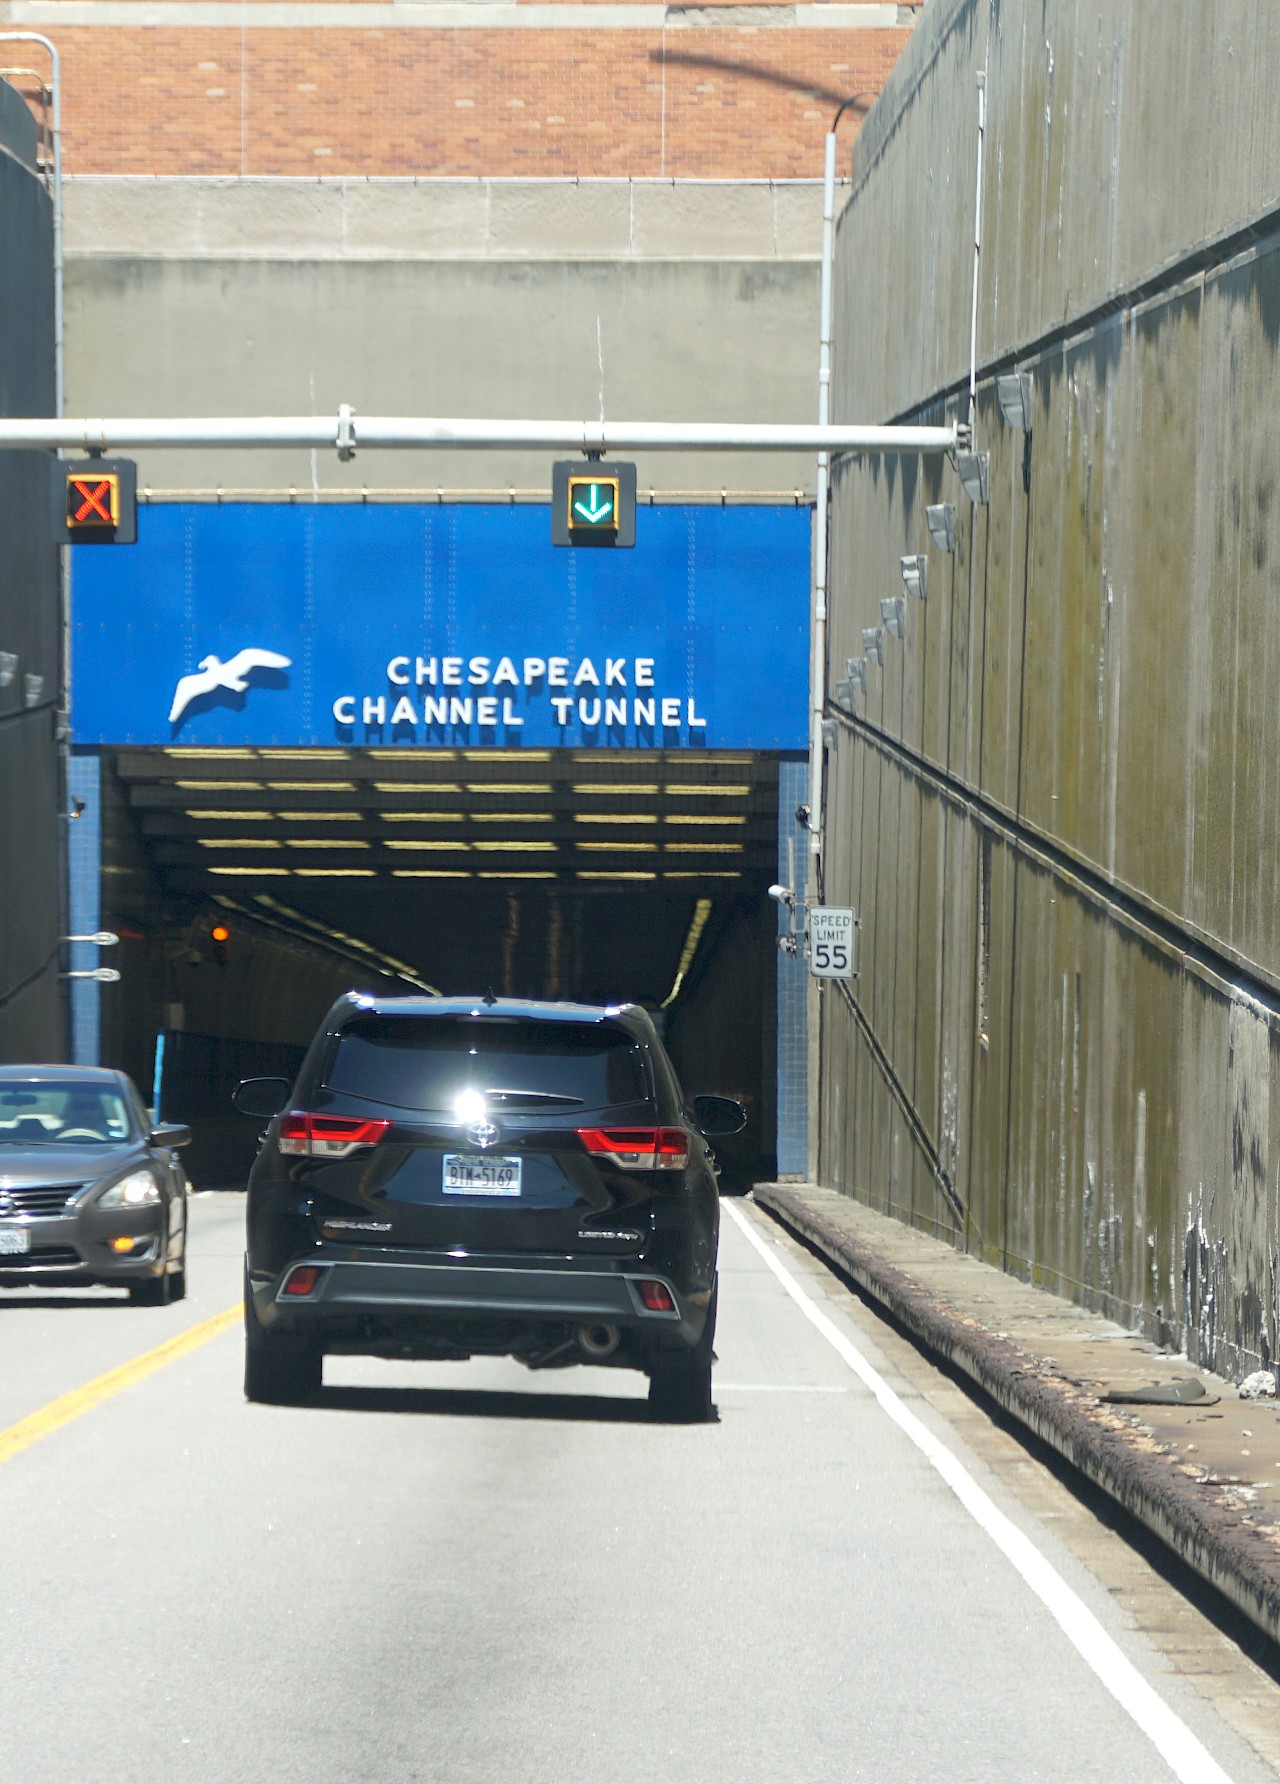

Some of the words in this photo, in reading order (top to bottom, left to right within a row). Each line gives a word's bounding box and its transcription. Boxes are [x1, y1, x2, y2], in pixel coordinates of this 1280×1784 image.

[386, 656, 655, 687] CHESAPEAKE
[332, 695, 525, 726] CHANNEL
[550, 697, 707, 727] TUNNEL
[813, 915, 851, 927] SPEED
[816, 929, 846, 942] LIMIT
[815, 944, 848, 970] 55
